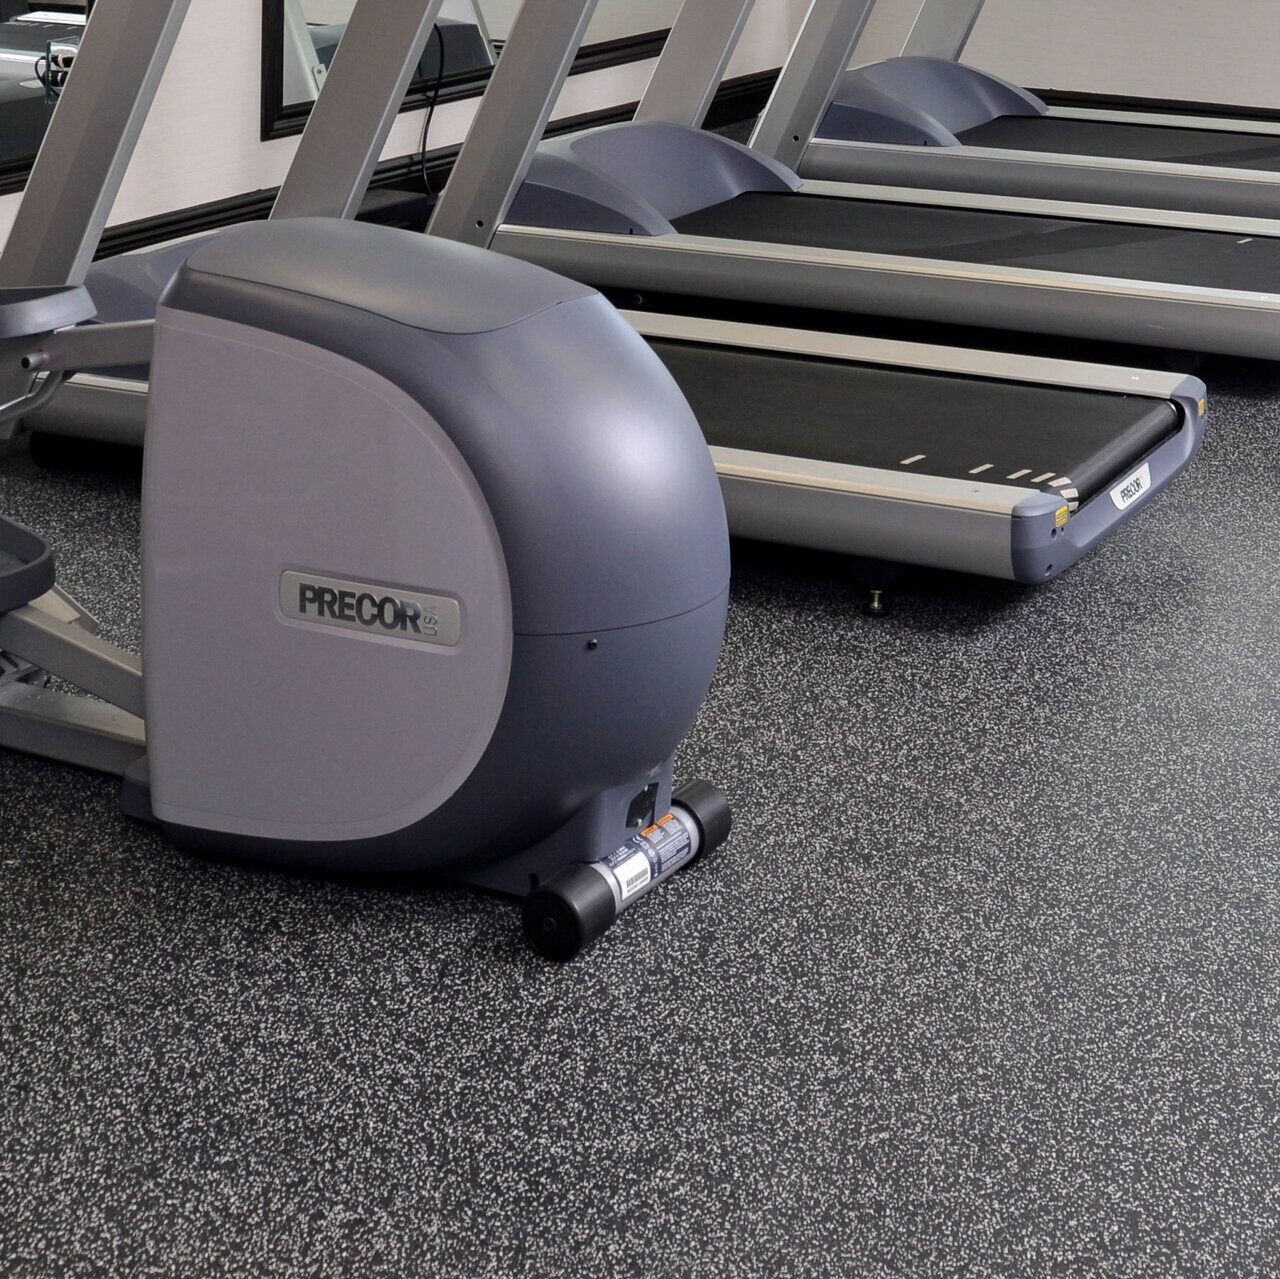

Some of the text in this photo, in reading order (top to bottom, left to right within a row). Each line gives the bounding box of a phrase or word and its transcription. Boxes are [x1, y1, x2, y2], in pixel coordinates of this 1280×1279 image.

[1120, 477, 1142, 503] PRECOR
[300, 583, 438, 636] PRECOR USA
